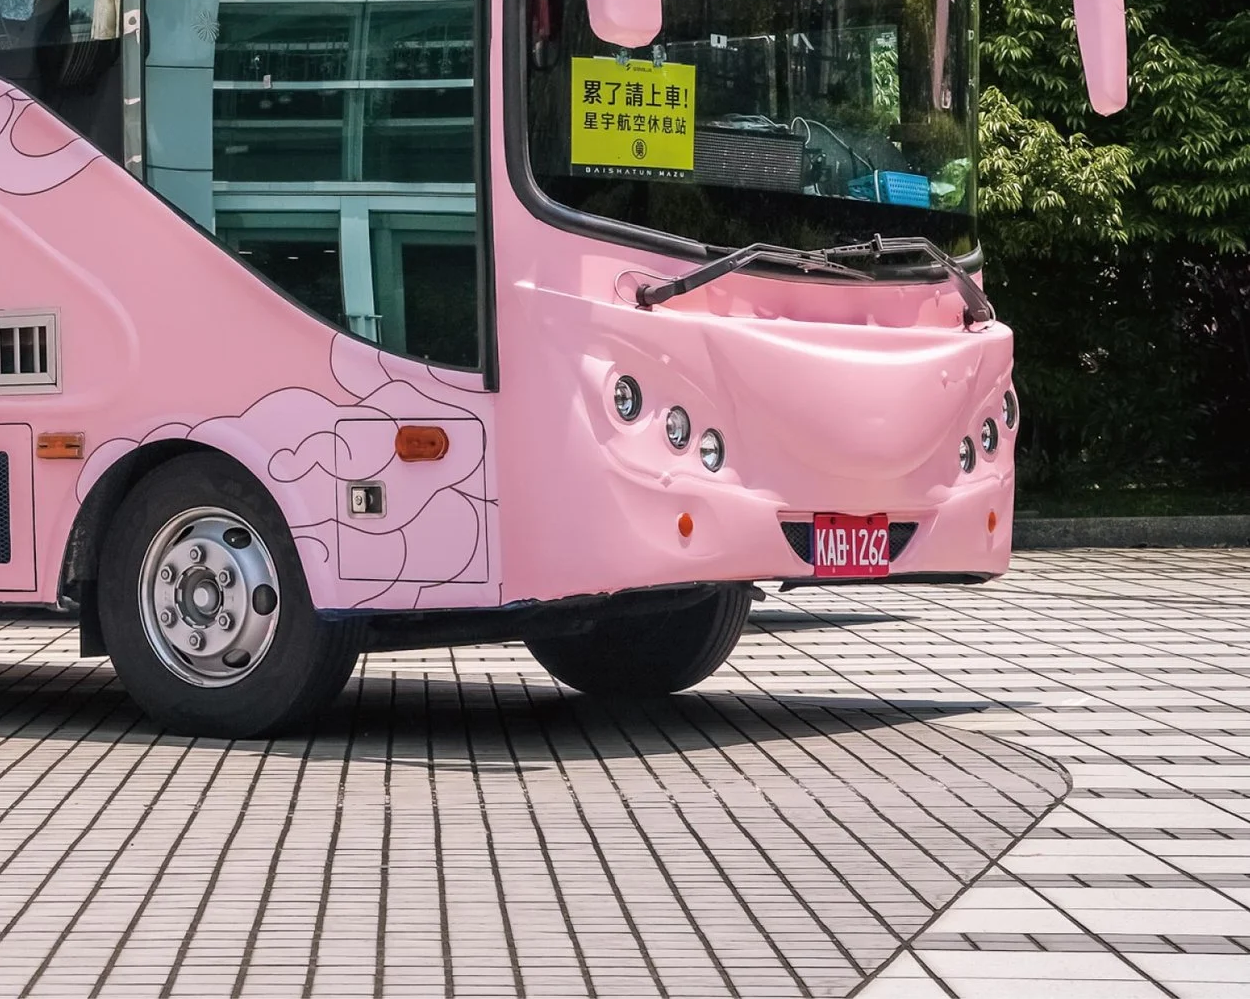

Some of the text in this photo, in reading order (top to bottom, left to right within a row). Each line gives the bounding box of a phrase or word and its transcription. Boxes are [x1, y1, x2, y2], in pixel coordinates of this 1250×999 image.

[583, 80, 688, 109] 累了請上車!
[584, 112, 687, 135] 星宇航空休息站
[585, 166, 685, 178] BAISHATUN MAZU
[816, 528, 889, 566] KAB-1262
